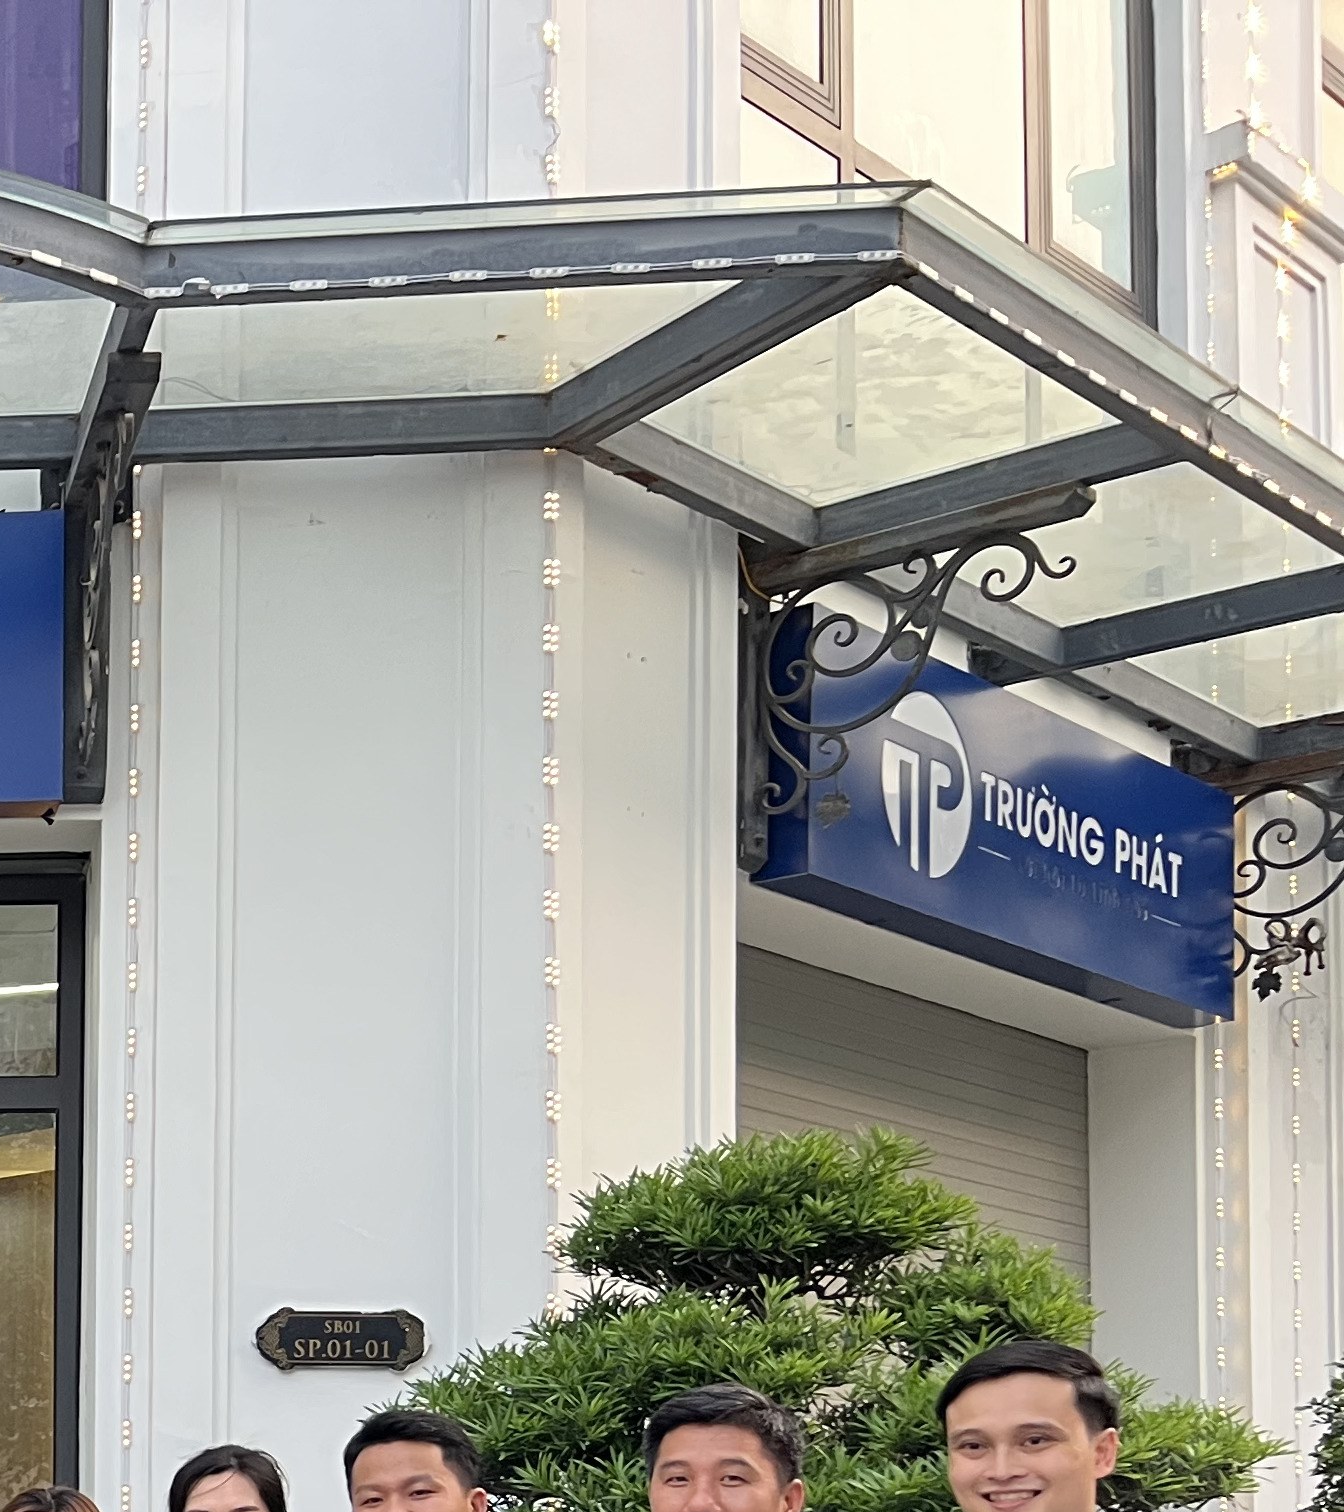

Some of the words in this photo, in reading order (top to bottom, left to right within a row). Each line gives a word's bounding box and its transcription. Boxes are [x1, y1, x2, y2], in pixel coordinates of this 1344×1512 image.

[980, 771, 1105, 866] TRƯỜNG
[1114, 828, 1183, 898] PHÁT
[323, 1319, 361, 1334] SB01
[293, 1338, 391, 1359] SP.01-01
